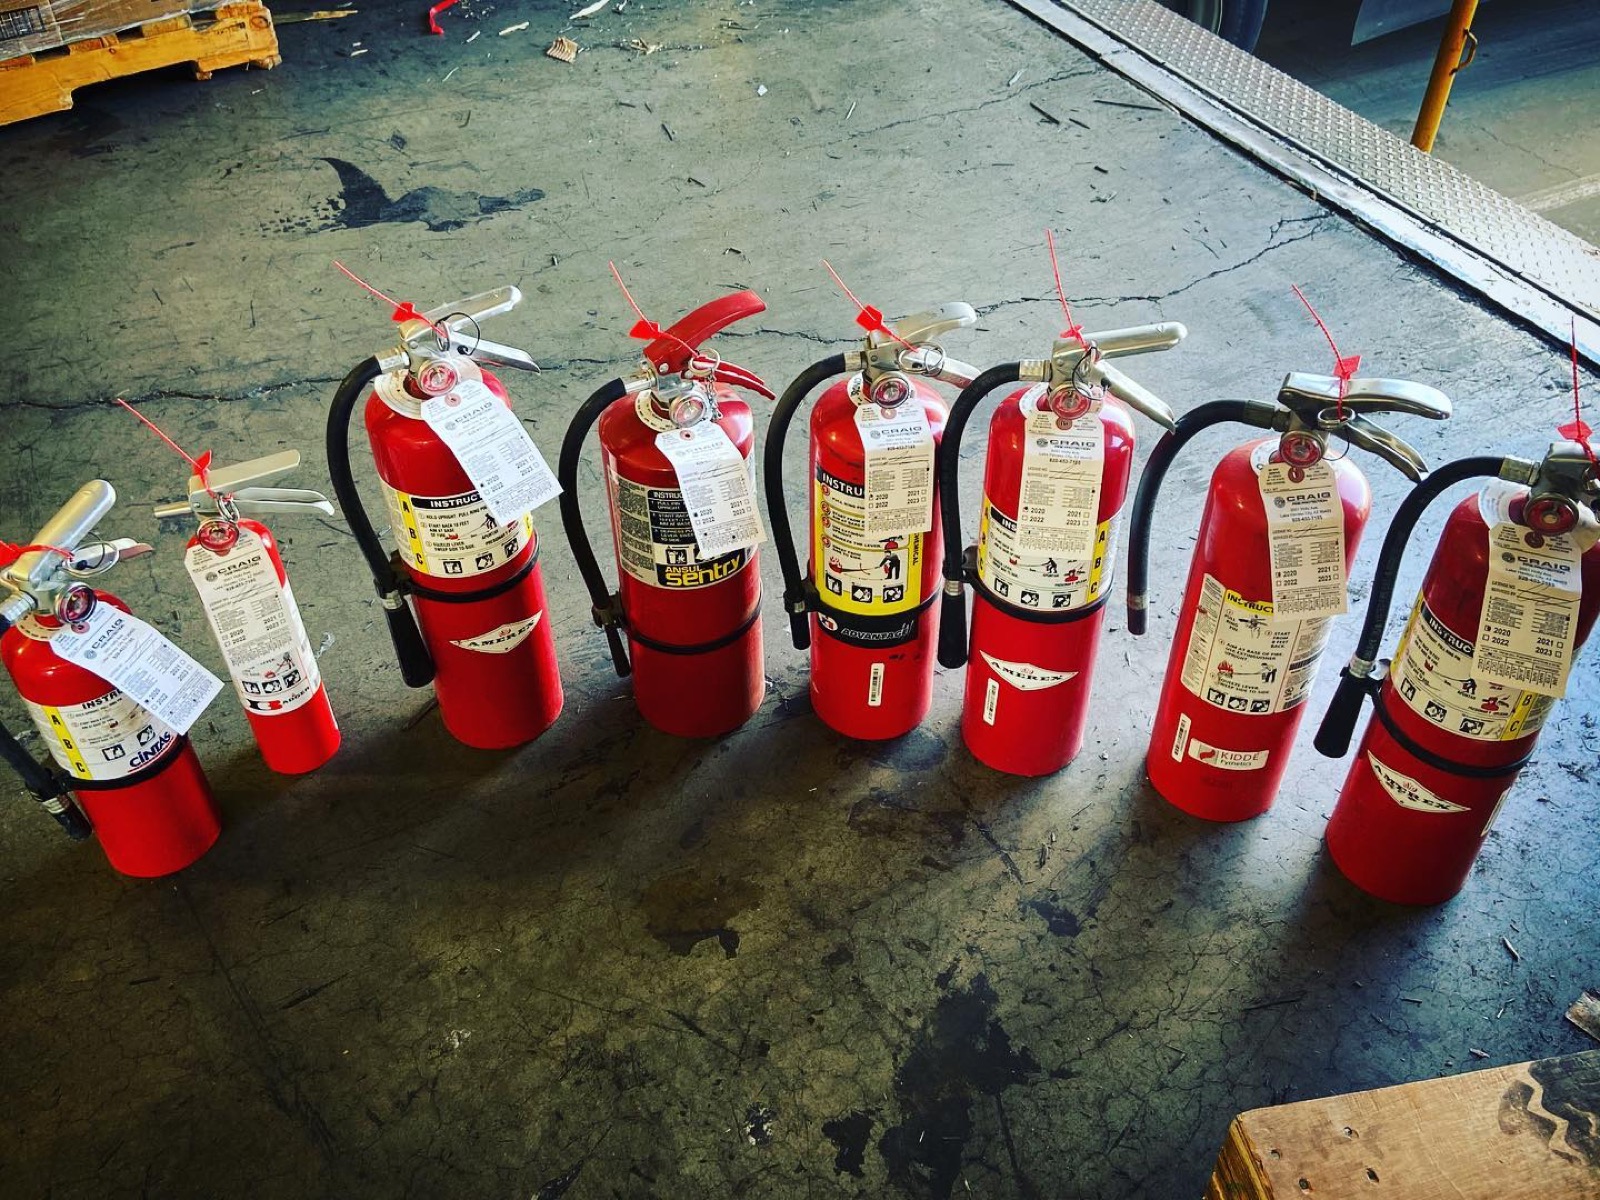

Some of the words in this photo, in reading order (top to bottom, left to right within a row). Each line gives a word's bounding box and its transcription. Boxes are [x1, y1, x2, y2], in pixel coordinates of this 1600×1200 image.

[1050, 440, 1096, 448] CRAIG
[822, 472, 864, 497] INSTRU
[1286, 492, 1331, 502] CRAIG
[409, 528, 417, 539] B
[1099, 530, 1106, 542] A
[416, 552, 424, 565] C
[1094, 557, 1102, 569] B
[1518, 556, 1570, 572] CRAIG
[218, 556, 262, 574] CRAIG
[1090, 582, 1098, 594] C
[264, 616, 277, 624] 2021
[1494, 627, 1510, 637] 2020
[1492, 636, 1510, 646] 2022
[1537, 638, 1554, 646] 2021
[1535, 647, 1552, 656] 2023
[991, 662, 1064, 680] AMEREX
[1522, 694, 1532, 706] B
[52, 714, 60, 726] A
[1509, 720, 1519, 732] C
[63, 739, 73, 750] B
[130, 731, 170, 768] CINTAS
[1221, 752, 1260, 761] KIDDE
[76, 762, 86, 772] C
